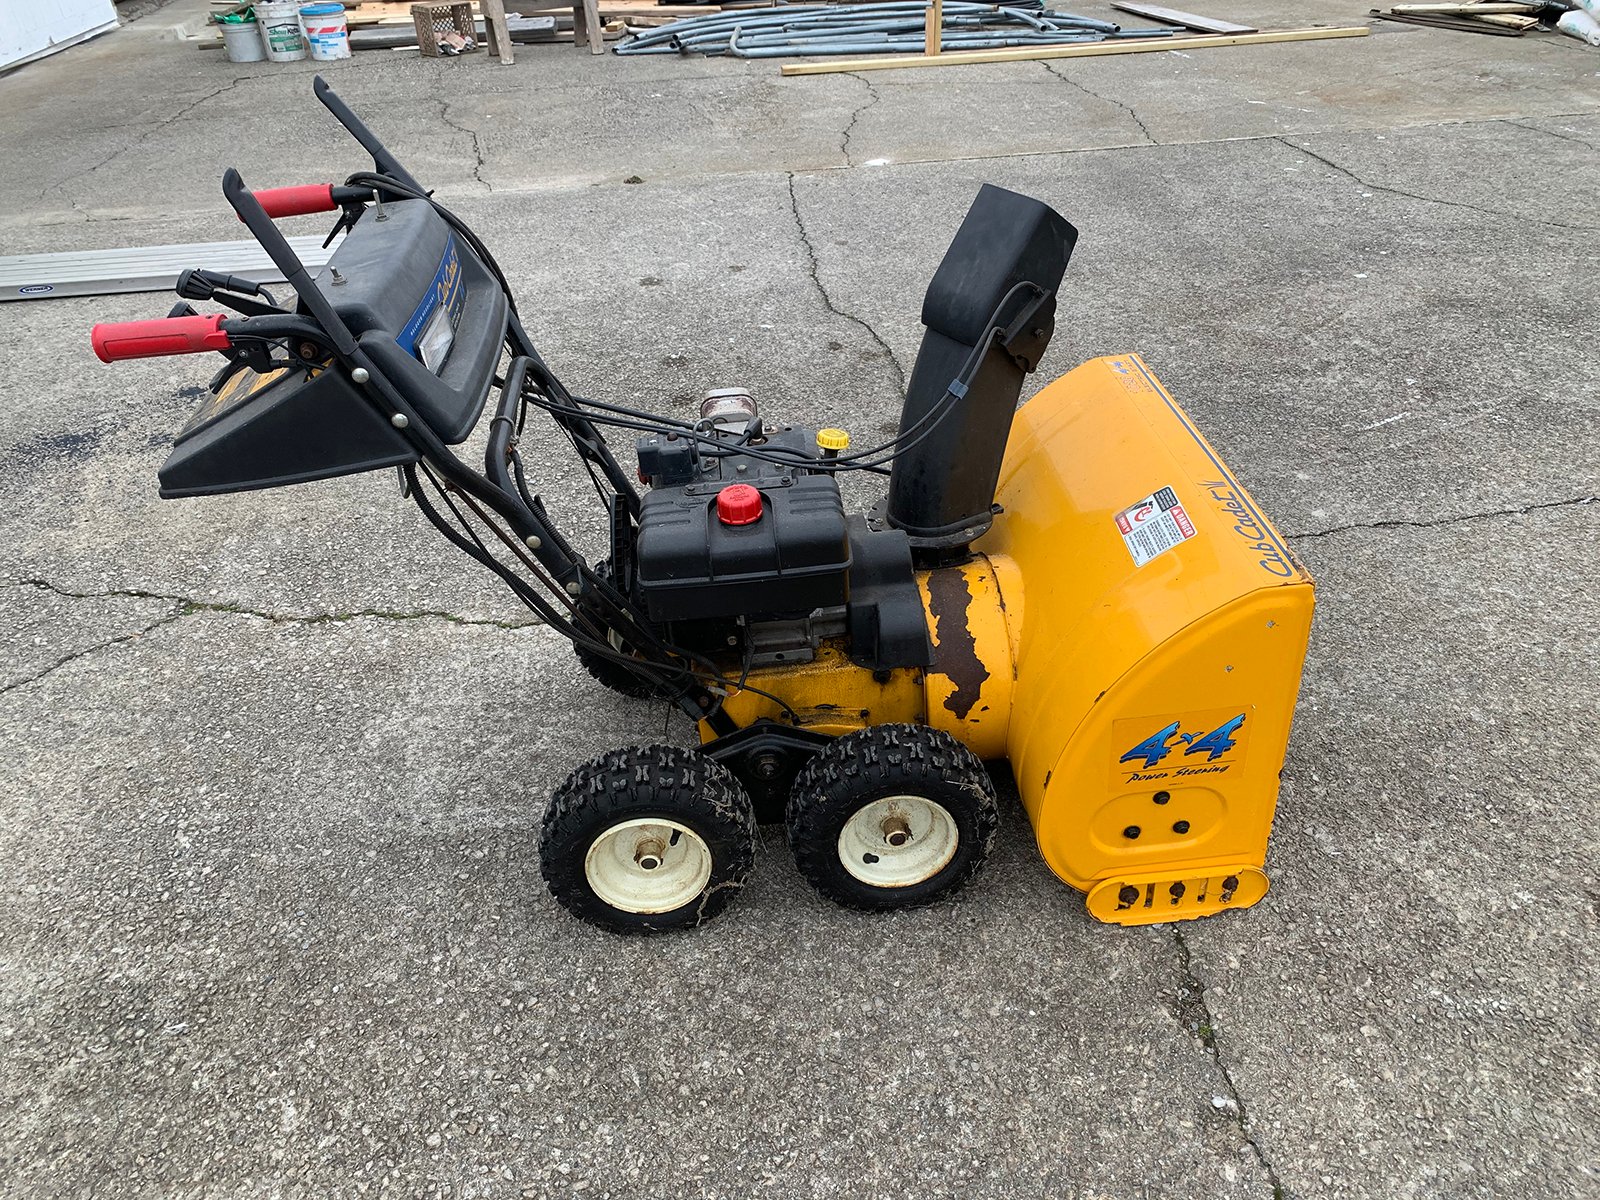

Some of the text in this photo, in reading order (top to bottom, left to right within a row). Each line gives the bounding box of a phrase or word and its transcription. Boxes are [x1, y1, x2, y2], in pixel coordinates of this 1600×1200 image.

[1176, 513, 1193, 537] DANGER
[1125, 765, 1230, 784] Power Steering
